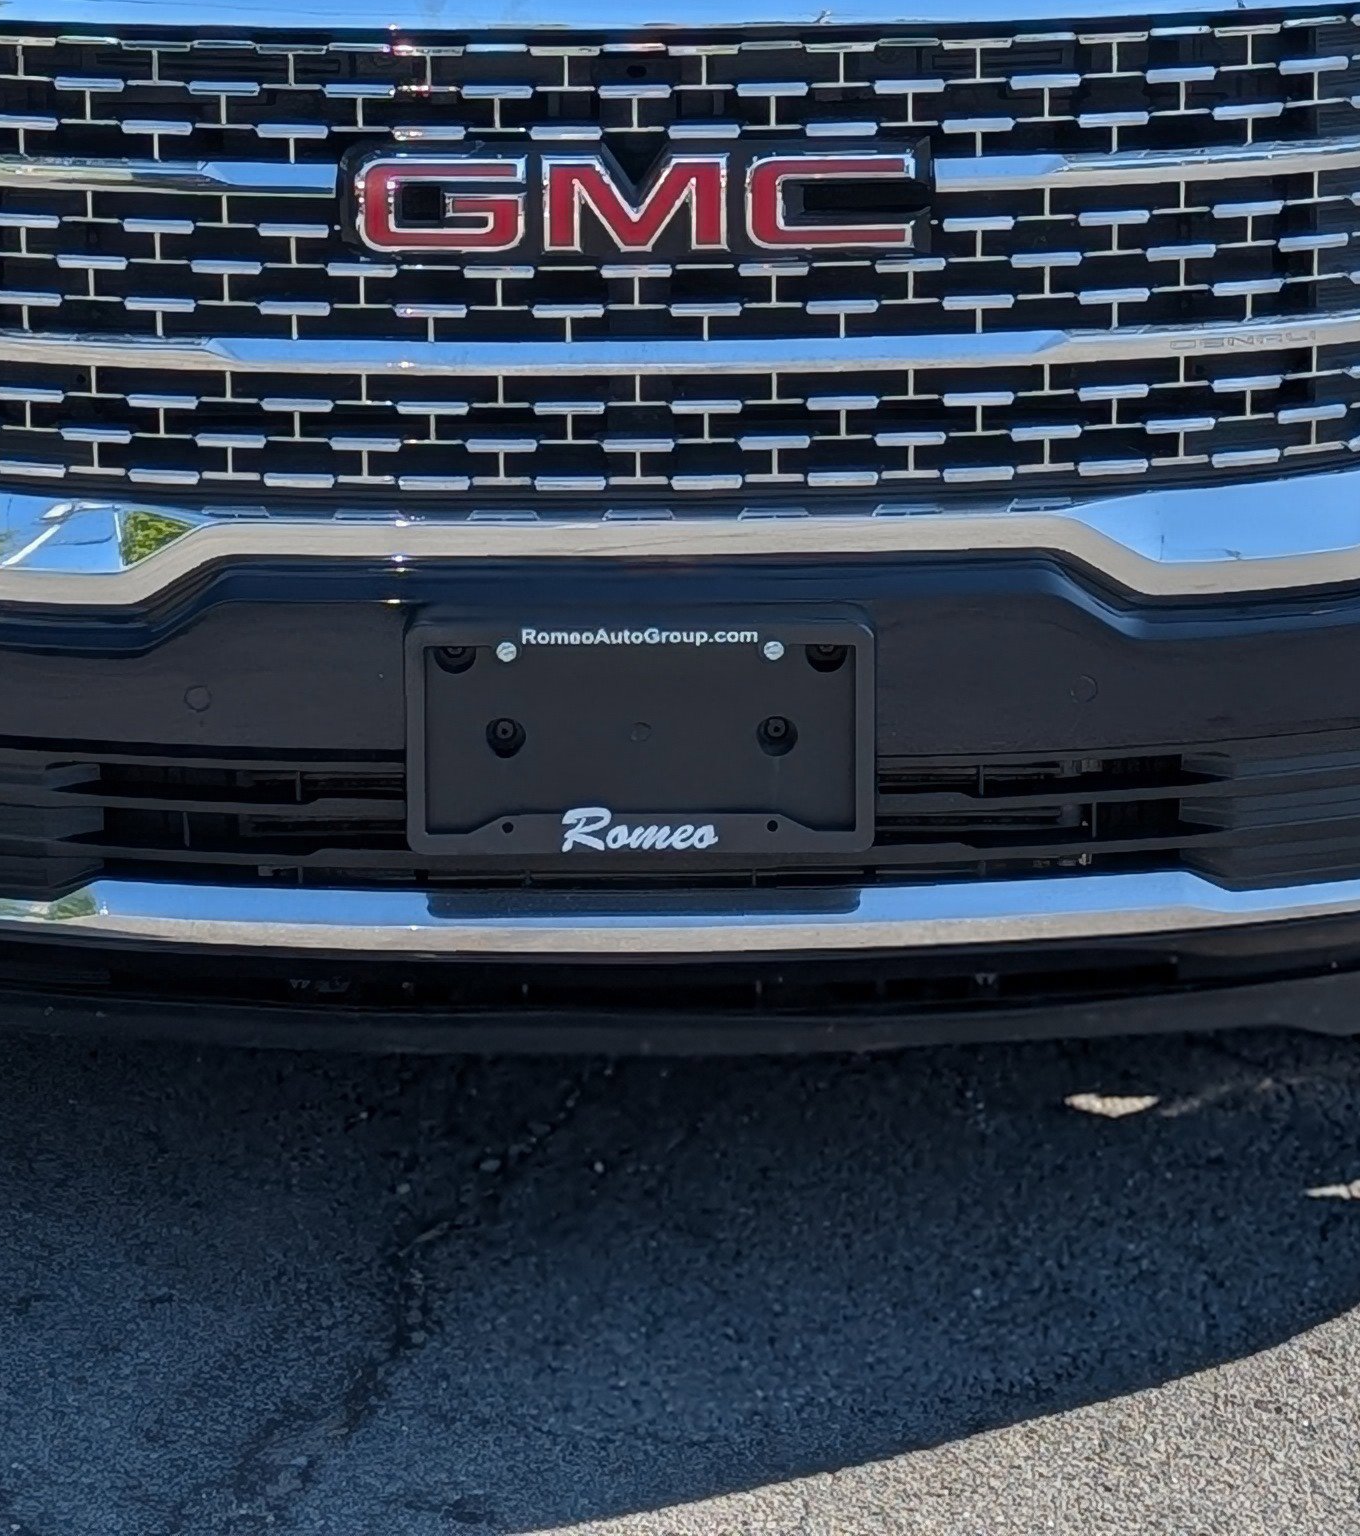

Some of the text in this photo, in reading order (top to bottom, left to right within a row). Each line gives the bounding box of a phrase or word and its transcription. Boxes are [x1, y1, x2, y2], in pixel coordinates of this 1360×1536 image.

[354, 153, 915, 252] GMC
[1169, 329, 1317, 351] DENALI
[520, 627, 759, 646] RomeoAutoGroup.com
[560, 806, 719, 852] Romeo
